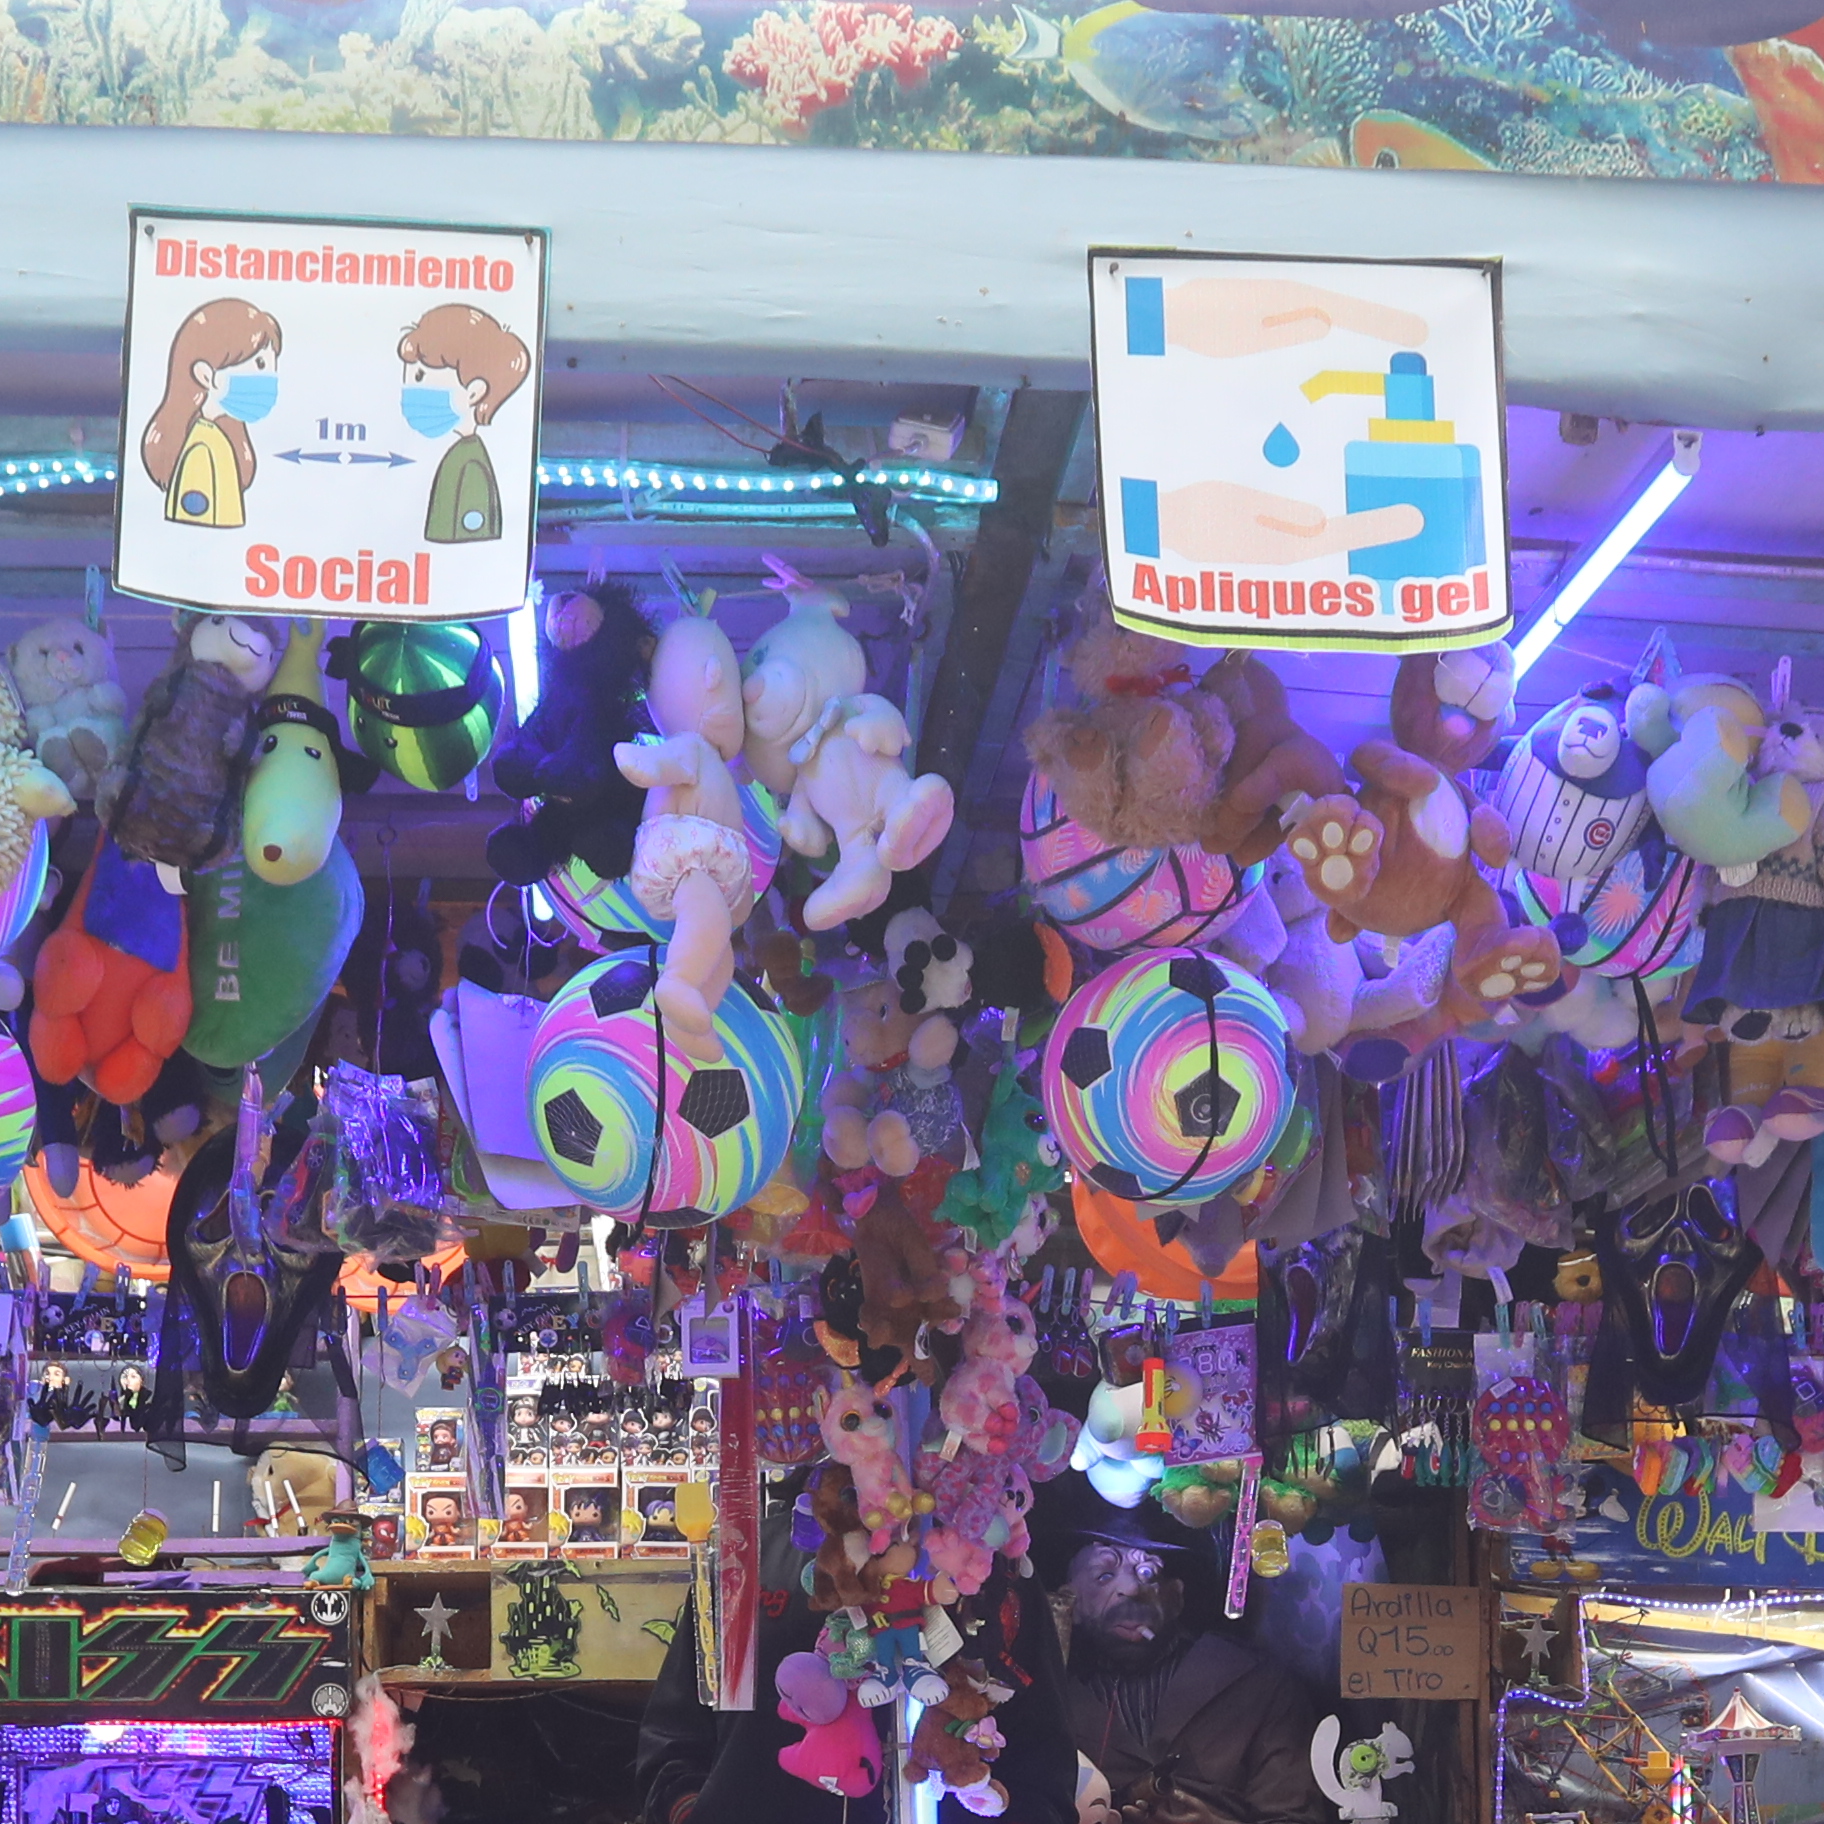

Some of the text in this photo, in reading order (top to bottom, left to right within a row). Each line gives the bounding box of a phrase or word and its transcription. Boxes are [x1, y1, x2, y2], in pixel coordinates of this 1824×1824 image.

[156, 239, 514, 292] Distanciamiento
[315, 415, 368, 443] 1m
[246, 543, 430, 605] Social
[1132, 563, 1490, 623] Apliques gel
[214, 940, 243, 1002] BE
[1409, 1347, 1464, 1359] FASHION
[1350, 1587, 1454, 1618] Ardilla
[1347, 1668, 1444, 1694] el Tiro
